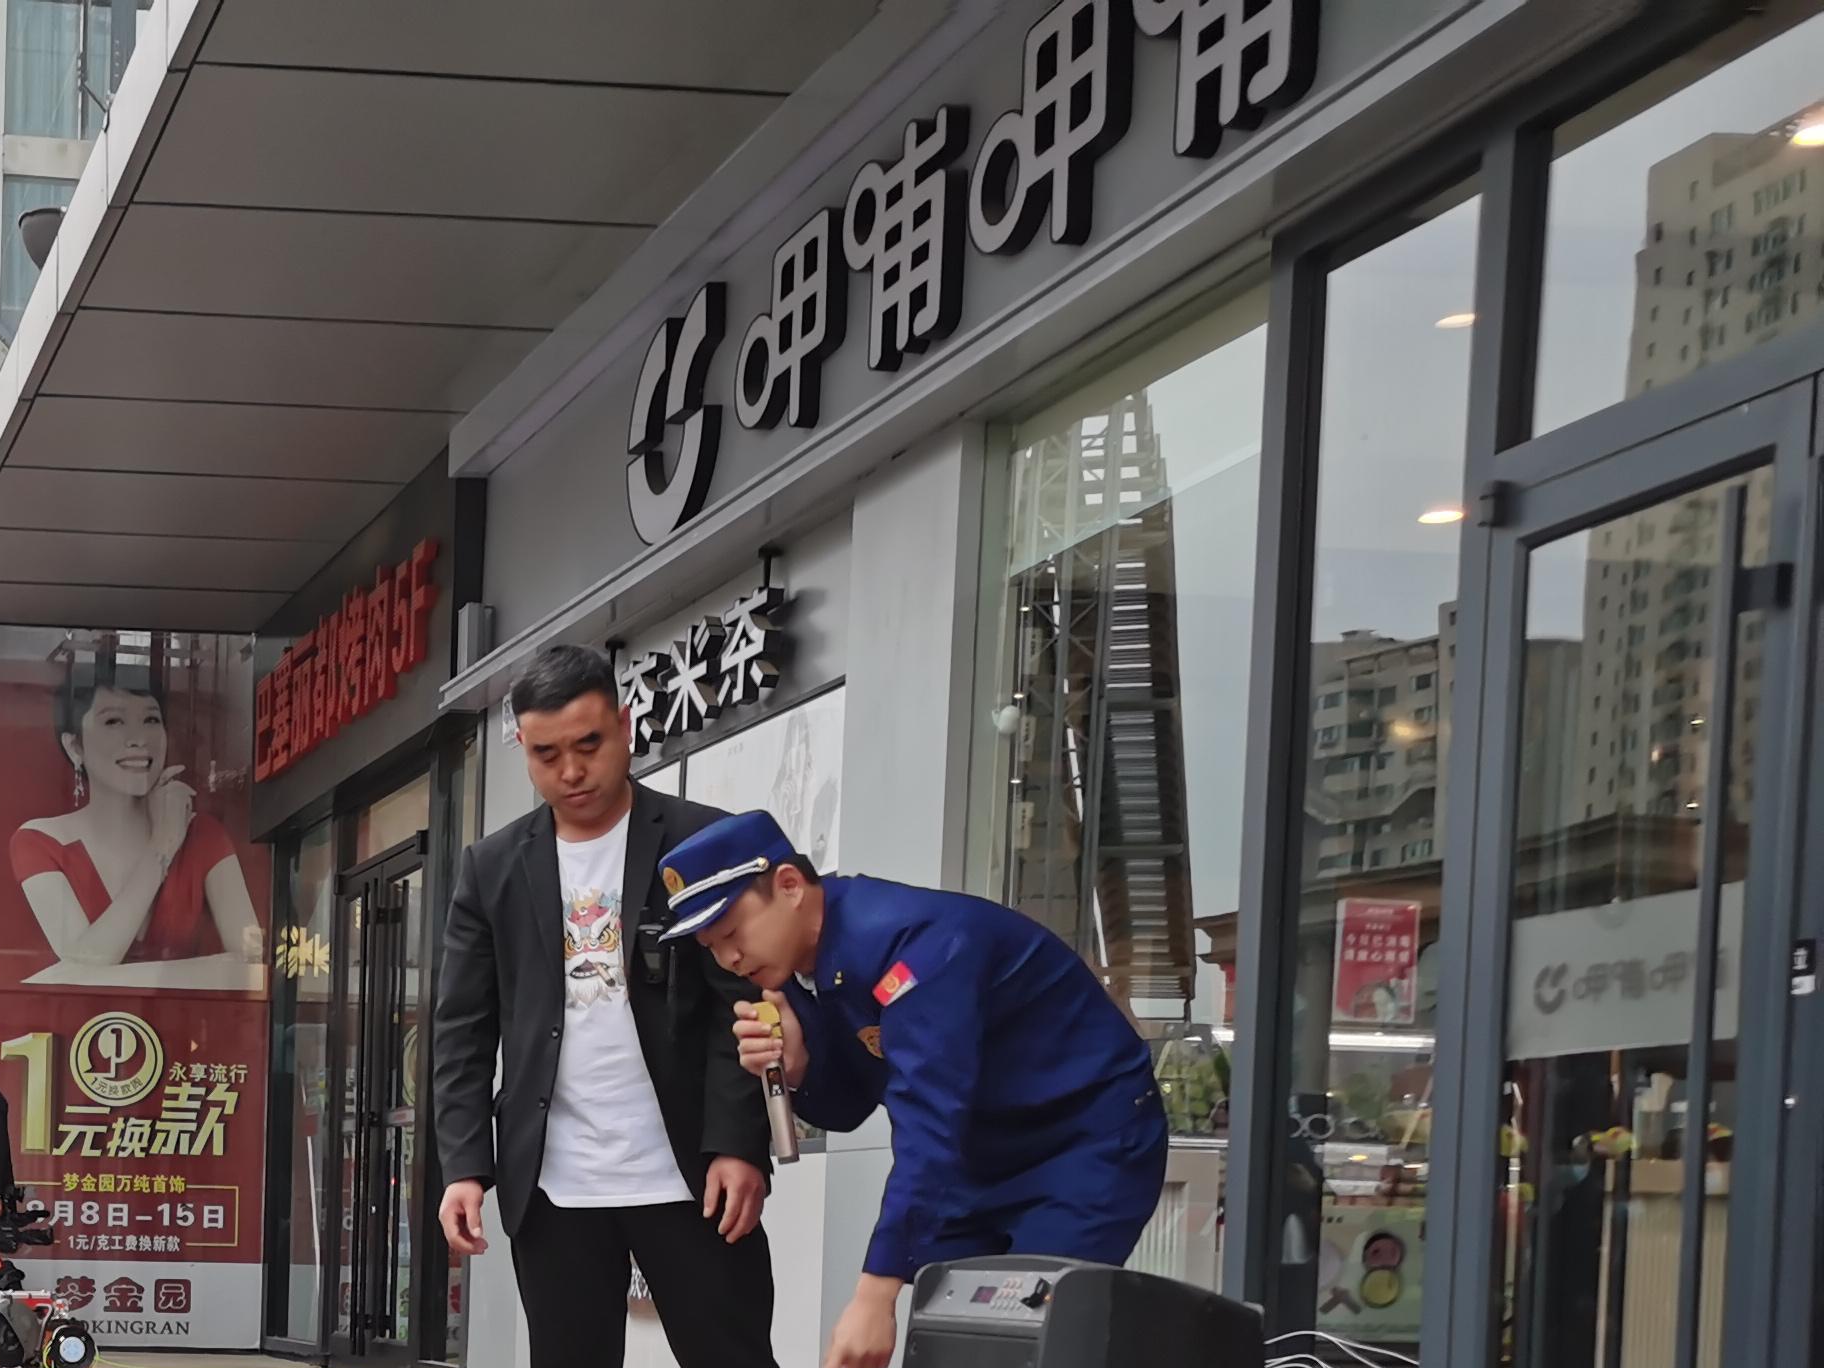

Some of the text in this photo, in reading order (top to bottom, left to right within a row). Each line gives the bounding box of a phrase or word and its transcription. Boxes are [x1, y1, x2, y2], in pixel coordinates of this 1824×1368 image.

[169, 1062, 248, 1084] 永享流行
[63, 1173, 186, 1194] 梦金园万纯首饰
[68, 1234, 181, 1252] 1元/克工费换新款
[55, 1276, 191, 1313] 梦金园
[80, 1320, 190, 1336] OKINGRAN
